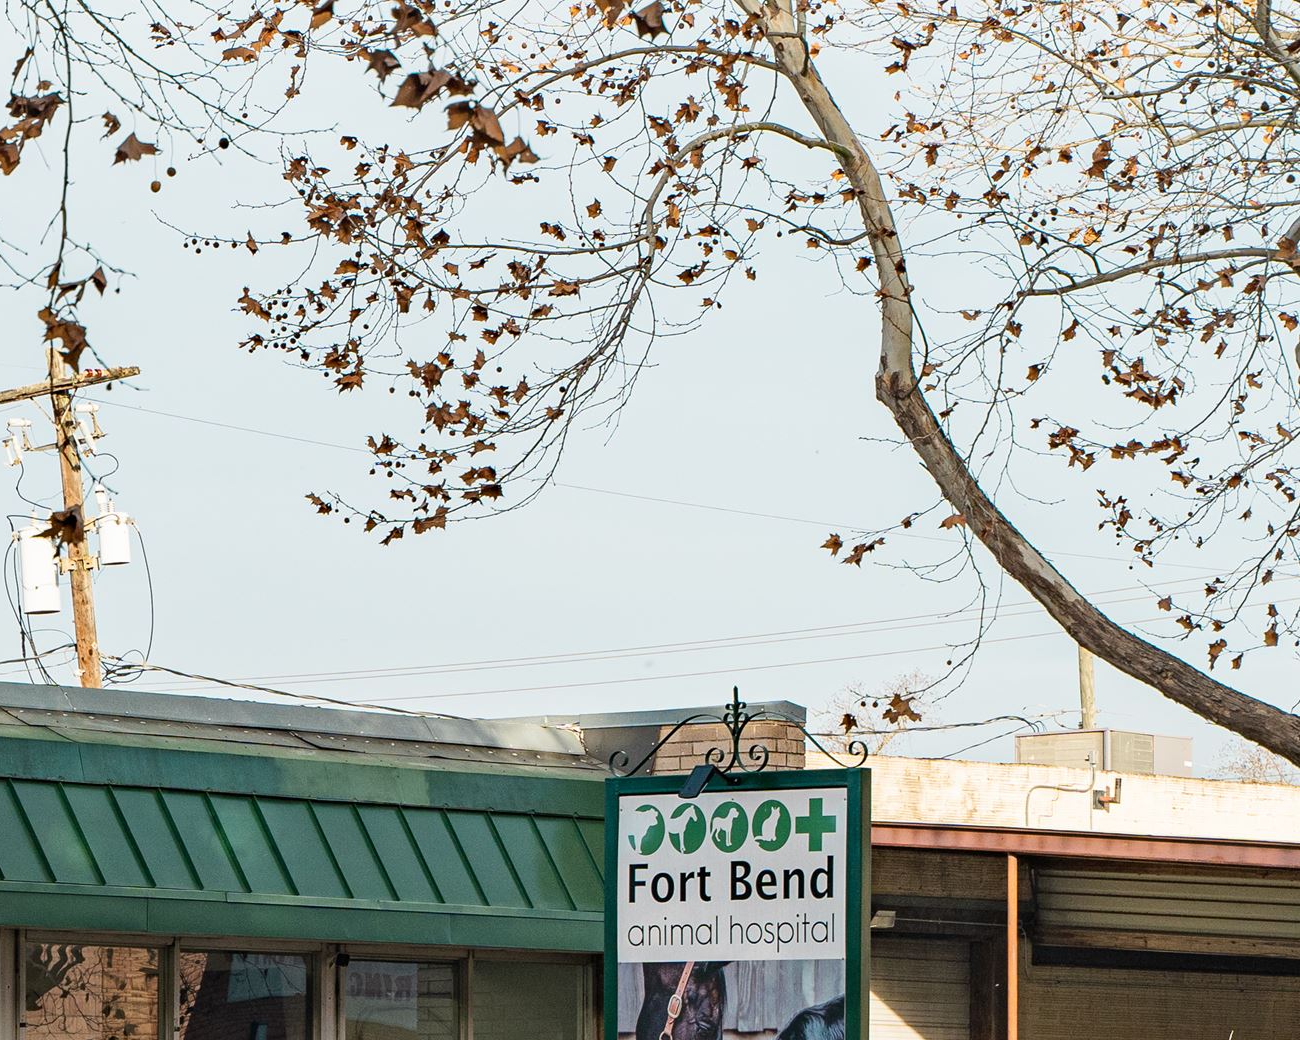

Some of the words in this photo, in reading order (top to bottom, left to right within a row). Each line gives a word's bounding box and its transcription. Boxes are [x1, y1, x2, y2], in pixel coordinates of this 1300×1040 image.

[628, 863, 712, 904] Fort
[730, 855, 834, 900] Bend
[627, 915, 719, 946] animal
[729, 912, 835, 953] hospital
